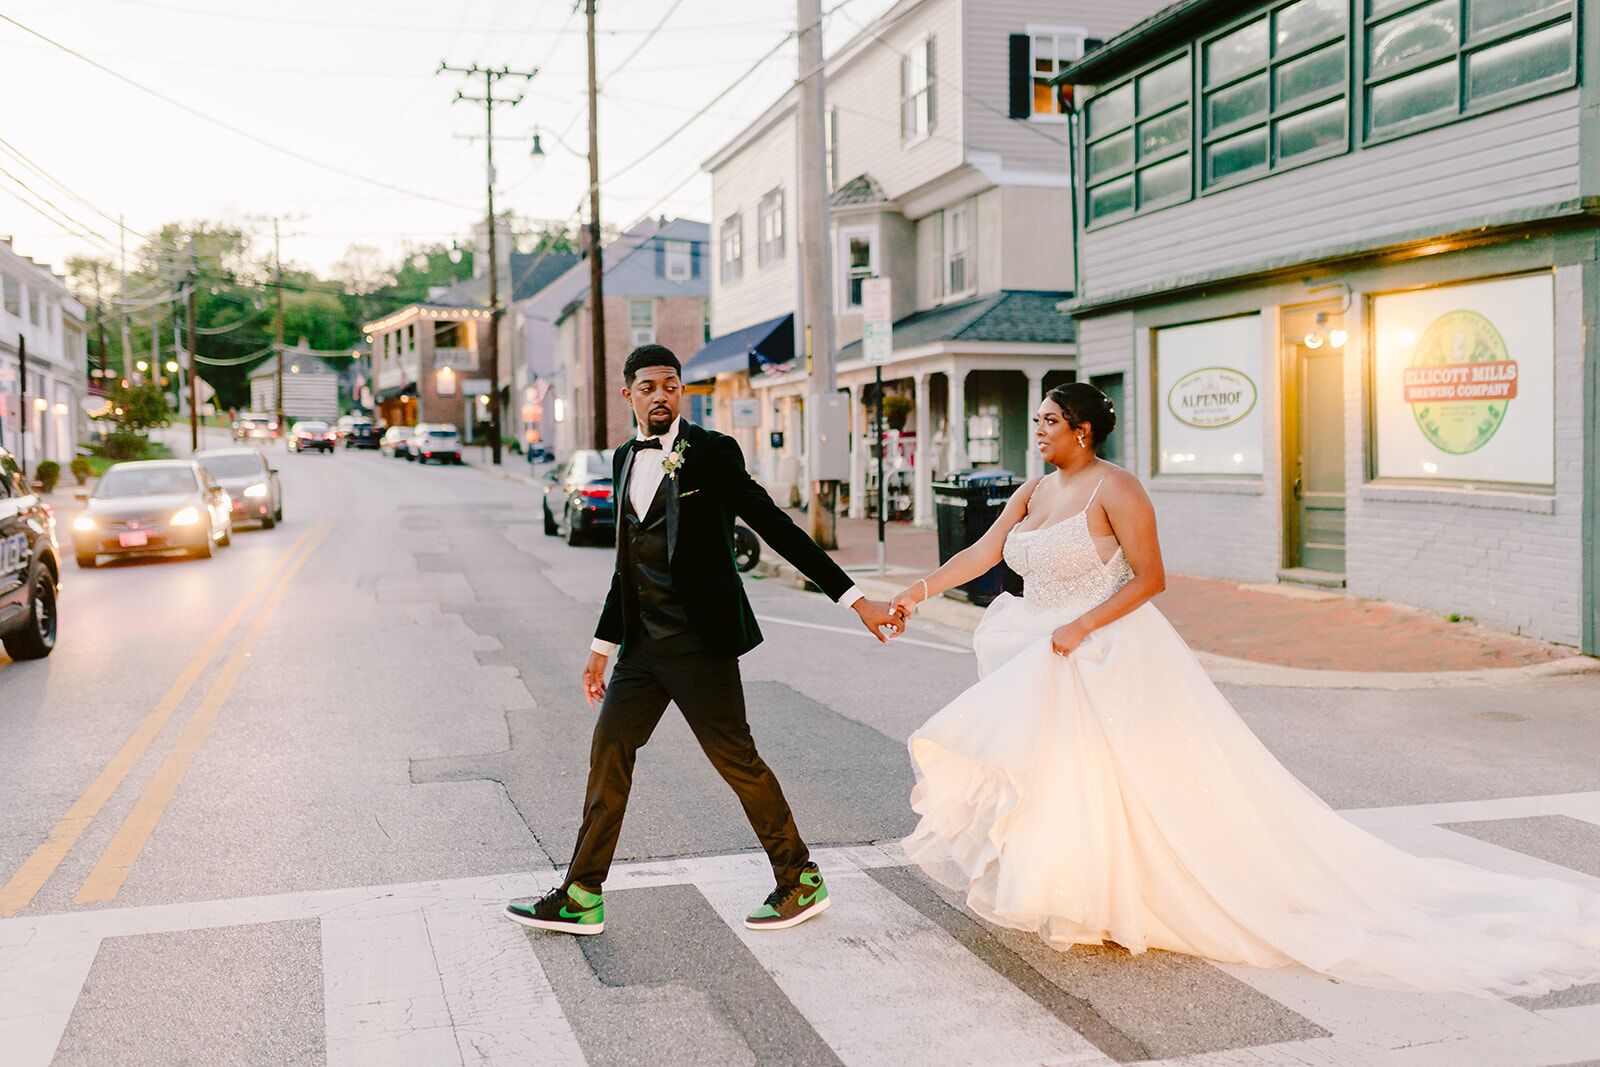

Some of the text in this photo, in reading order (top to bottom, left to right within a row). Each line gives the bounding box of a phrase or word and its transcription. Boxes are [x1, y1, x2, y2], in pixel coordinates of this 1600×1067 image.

[1405, 364, 1517, 386] ELLICOTT MILLS
[1181, 391, 1242, 409] ALPENHOF
[1408, 382, 1511, 400] BREWING COMPANY
